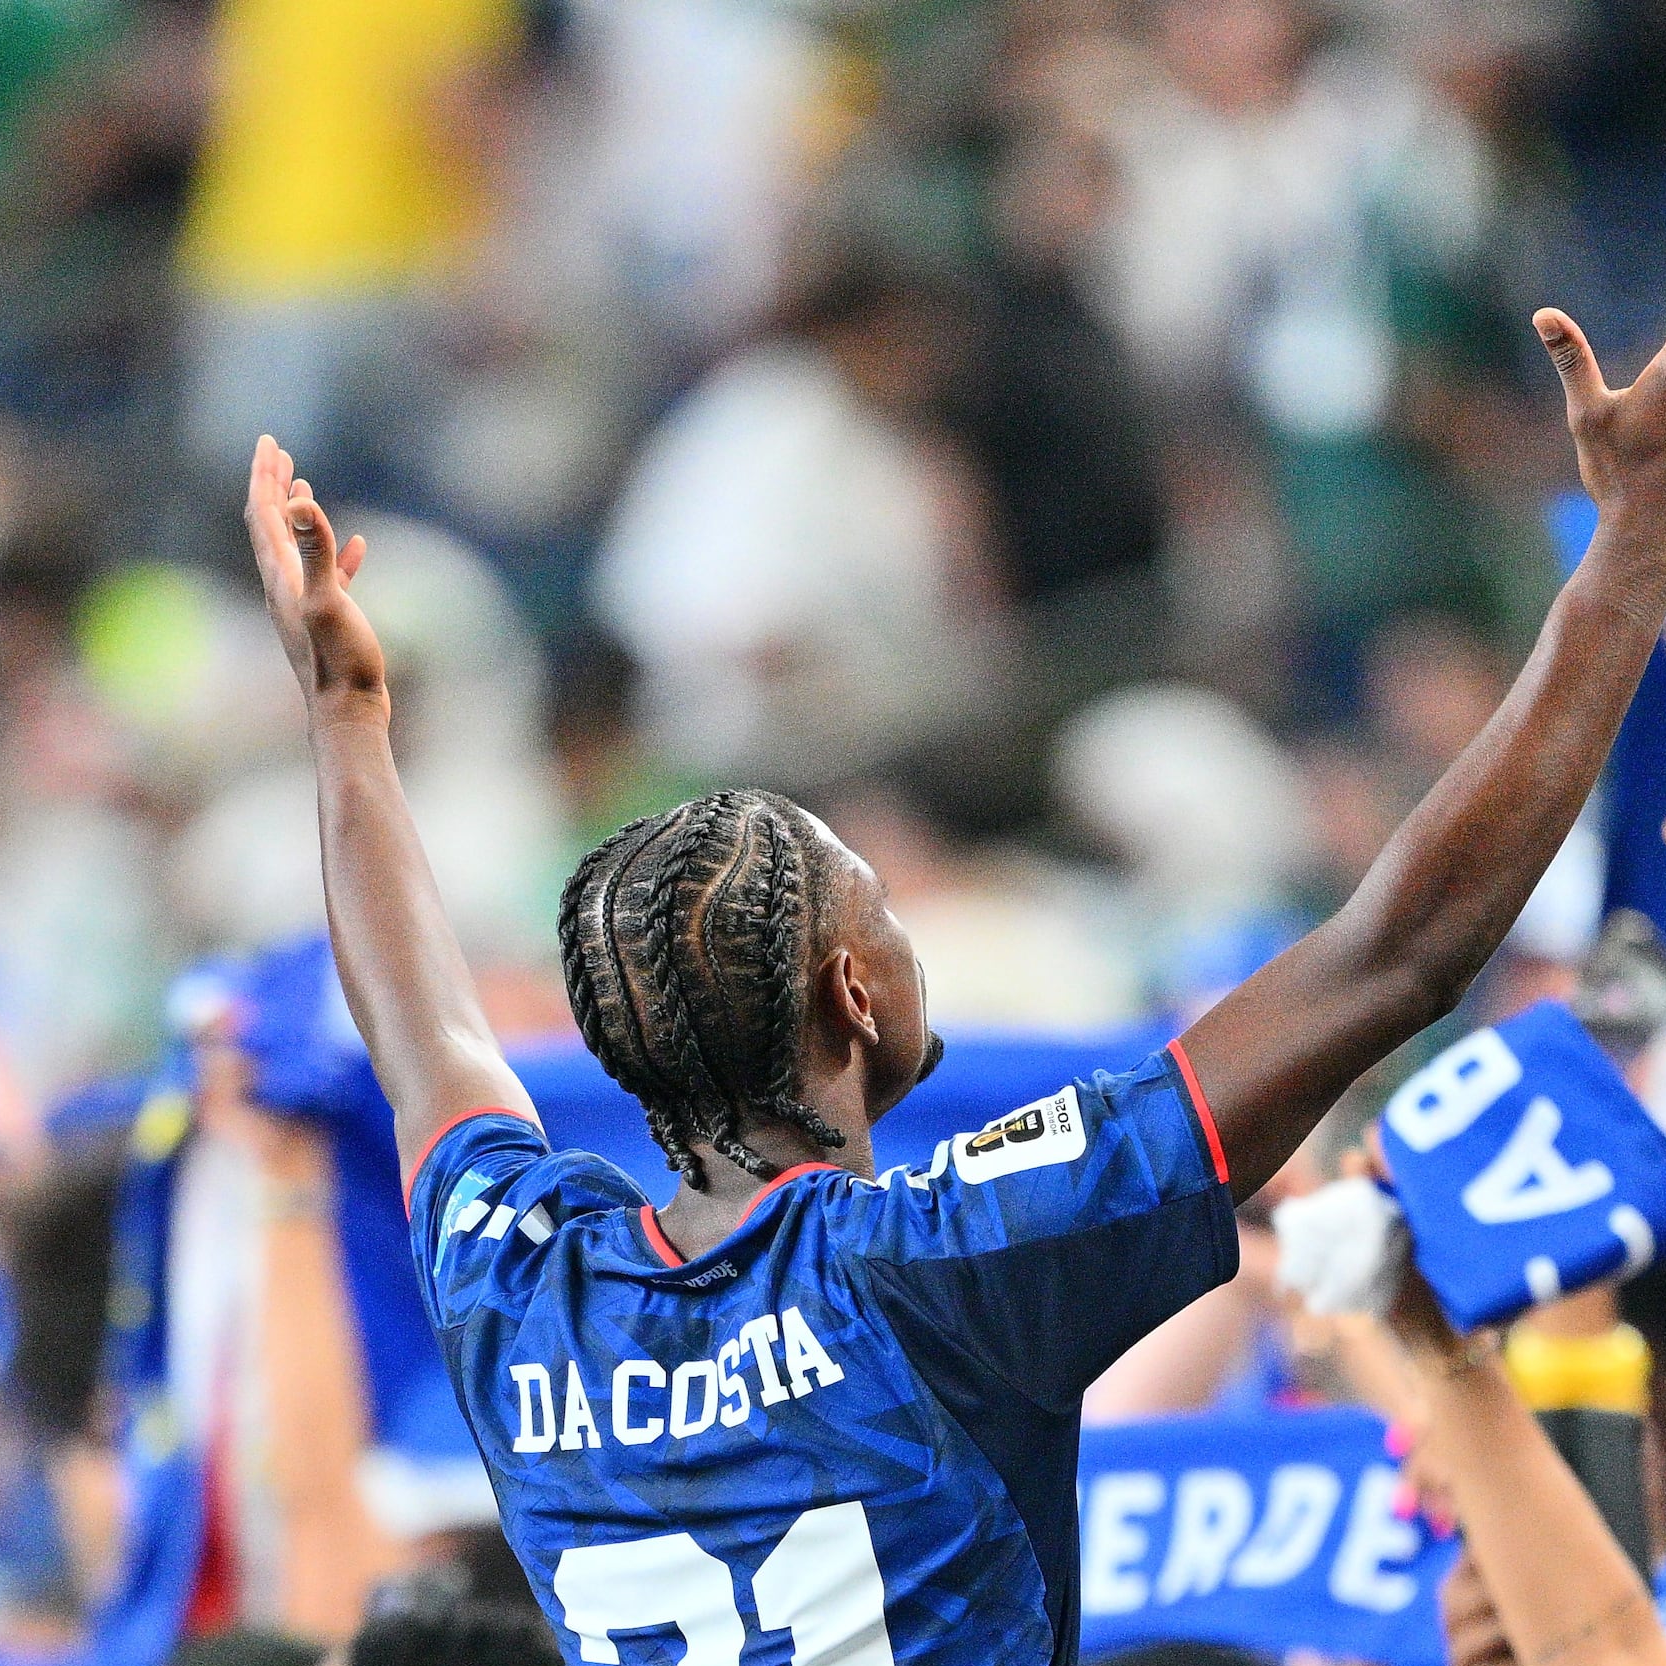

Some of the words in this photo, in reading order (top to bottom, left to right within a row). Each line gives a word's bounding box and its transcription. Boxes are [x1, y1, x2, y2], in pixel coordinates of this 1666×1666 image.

[1054, 1097, 1072, 1134] 2026
[509, 1359, 602, 1453] DA
[611, 1306, 845, 1446] COSTA
[1081, 1462, 1421, 1615] ERDE
